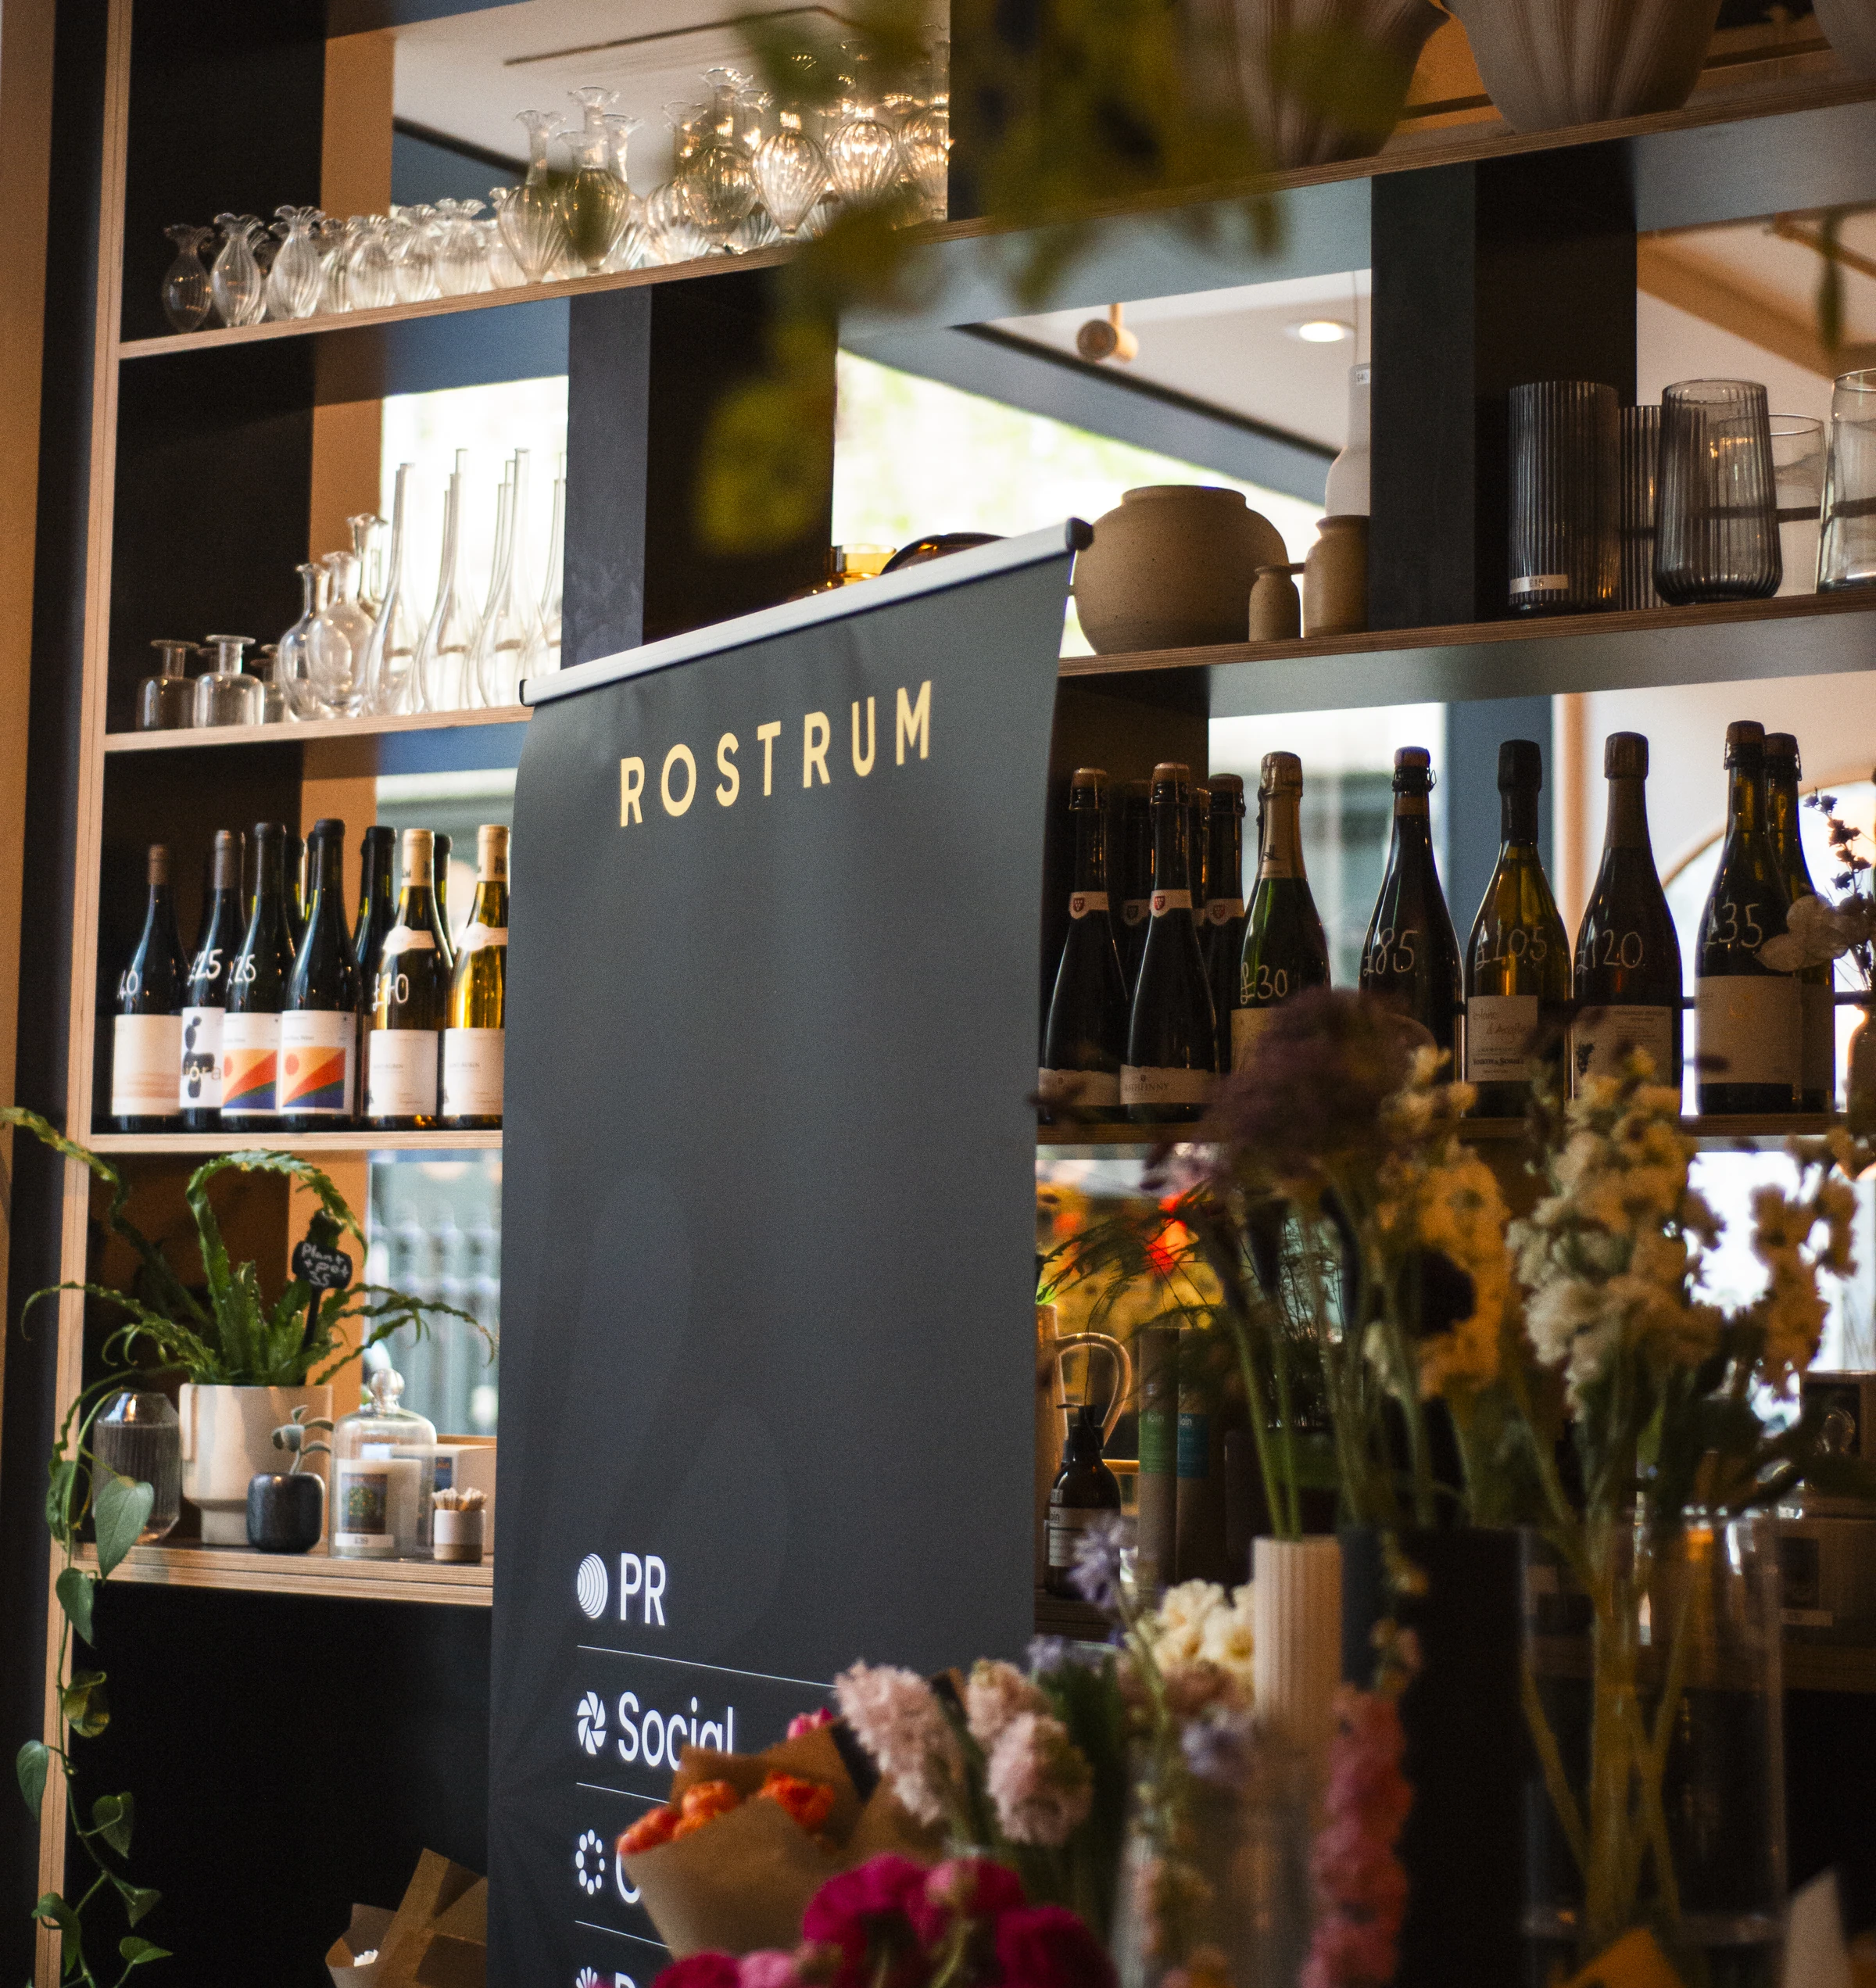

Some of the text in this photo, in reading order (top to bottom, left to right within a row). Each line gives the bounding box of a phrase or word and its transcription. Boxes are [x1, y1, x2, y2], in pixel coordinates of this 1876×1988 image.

[620, 680, 932, 827] ROSTRUM
[1362, 926, 1419, 977] £85
[1474, 922, 1548, 971] £105
[1577, 916, 1643, 975] £120
[1240, 962, 1289, 1005] £30
[621, 1553, 665, 1626] PR
